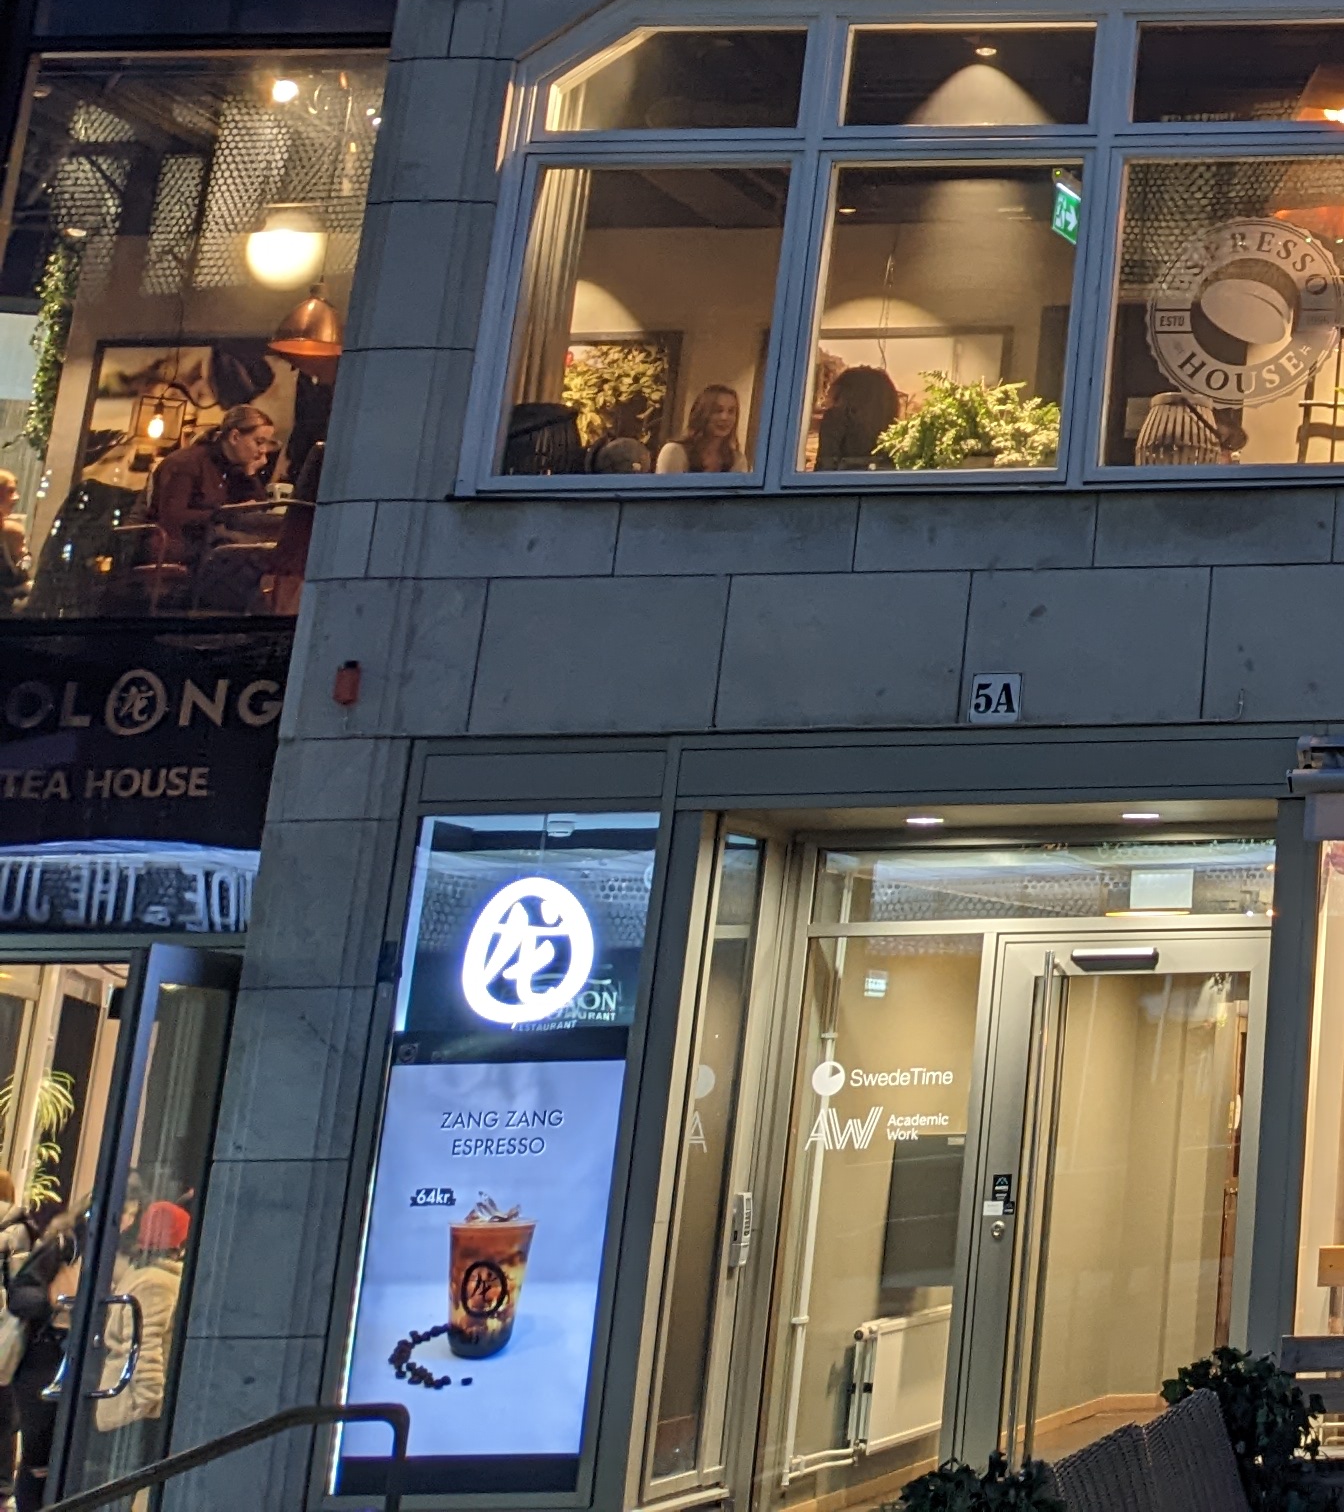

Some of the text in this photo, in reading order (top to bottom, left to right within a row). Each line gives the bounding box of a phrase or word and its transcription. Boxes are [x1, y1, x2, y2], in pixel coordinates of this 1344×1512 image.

[1179, 350, 1304, 395] HOUSE
[973, 682, 1016, 714] 5A
[0, 765, 211, 800] TEA HOUSE
[849, 1067, 954, 1087] SwedeTime
[440, 1108, 564, 1130] ZANG ZANG
[805, 1106, 884, 1151] AW
[887, 1112, 950, 1128] Academic
[887, 1128, 919, 1141] Work
[451, 1136, 546, 1156] ESPRESSO
[416, 1188, 450, 1205] 64kr
